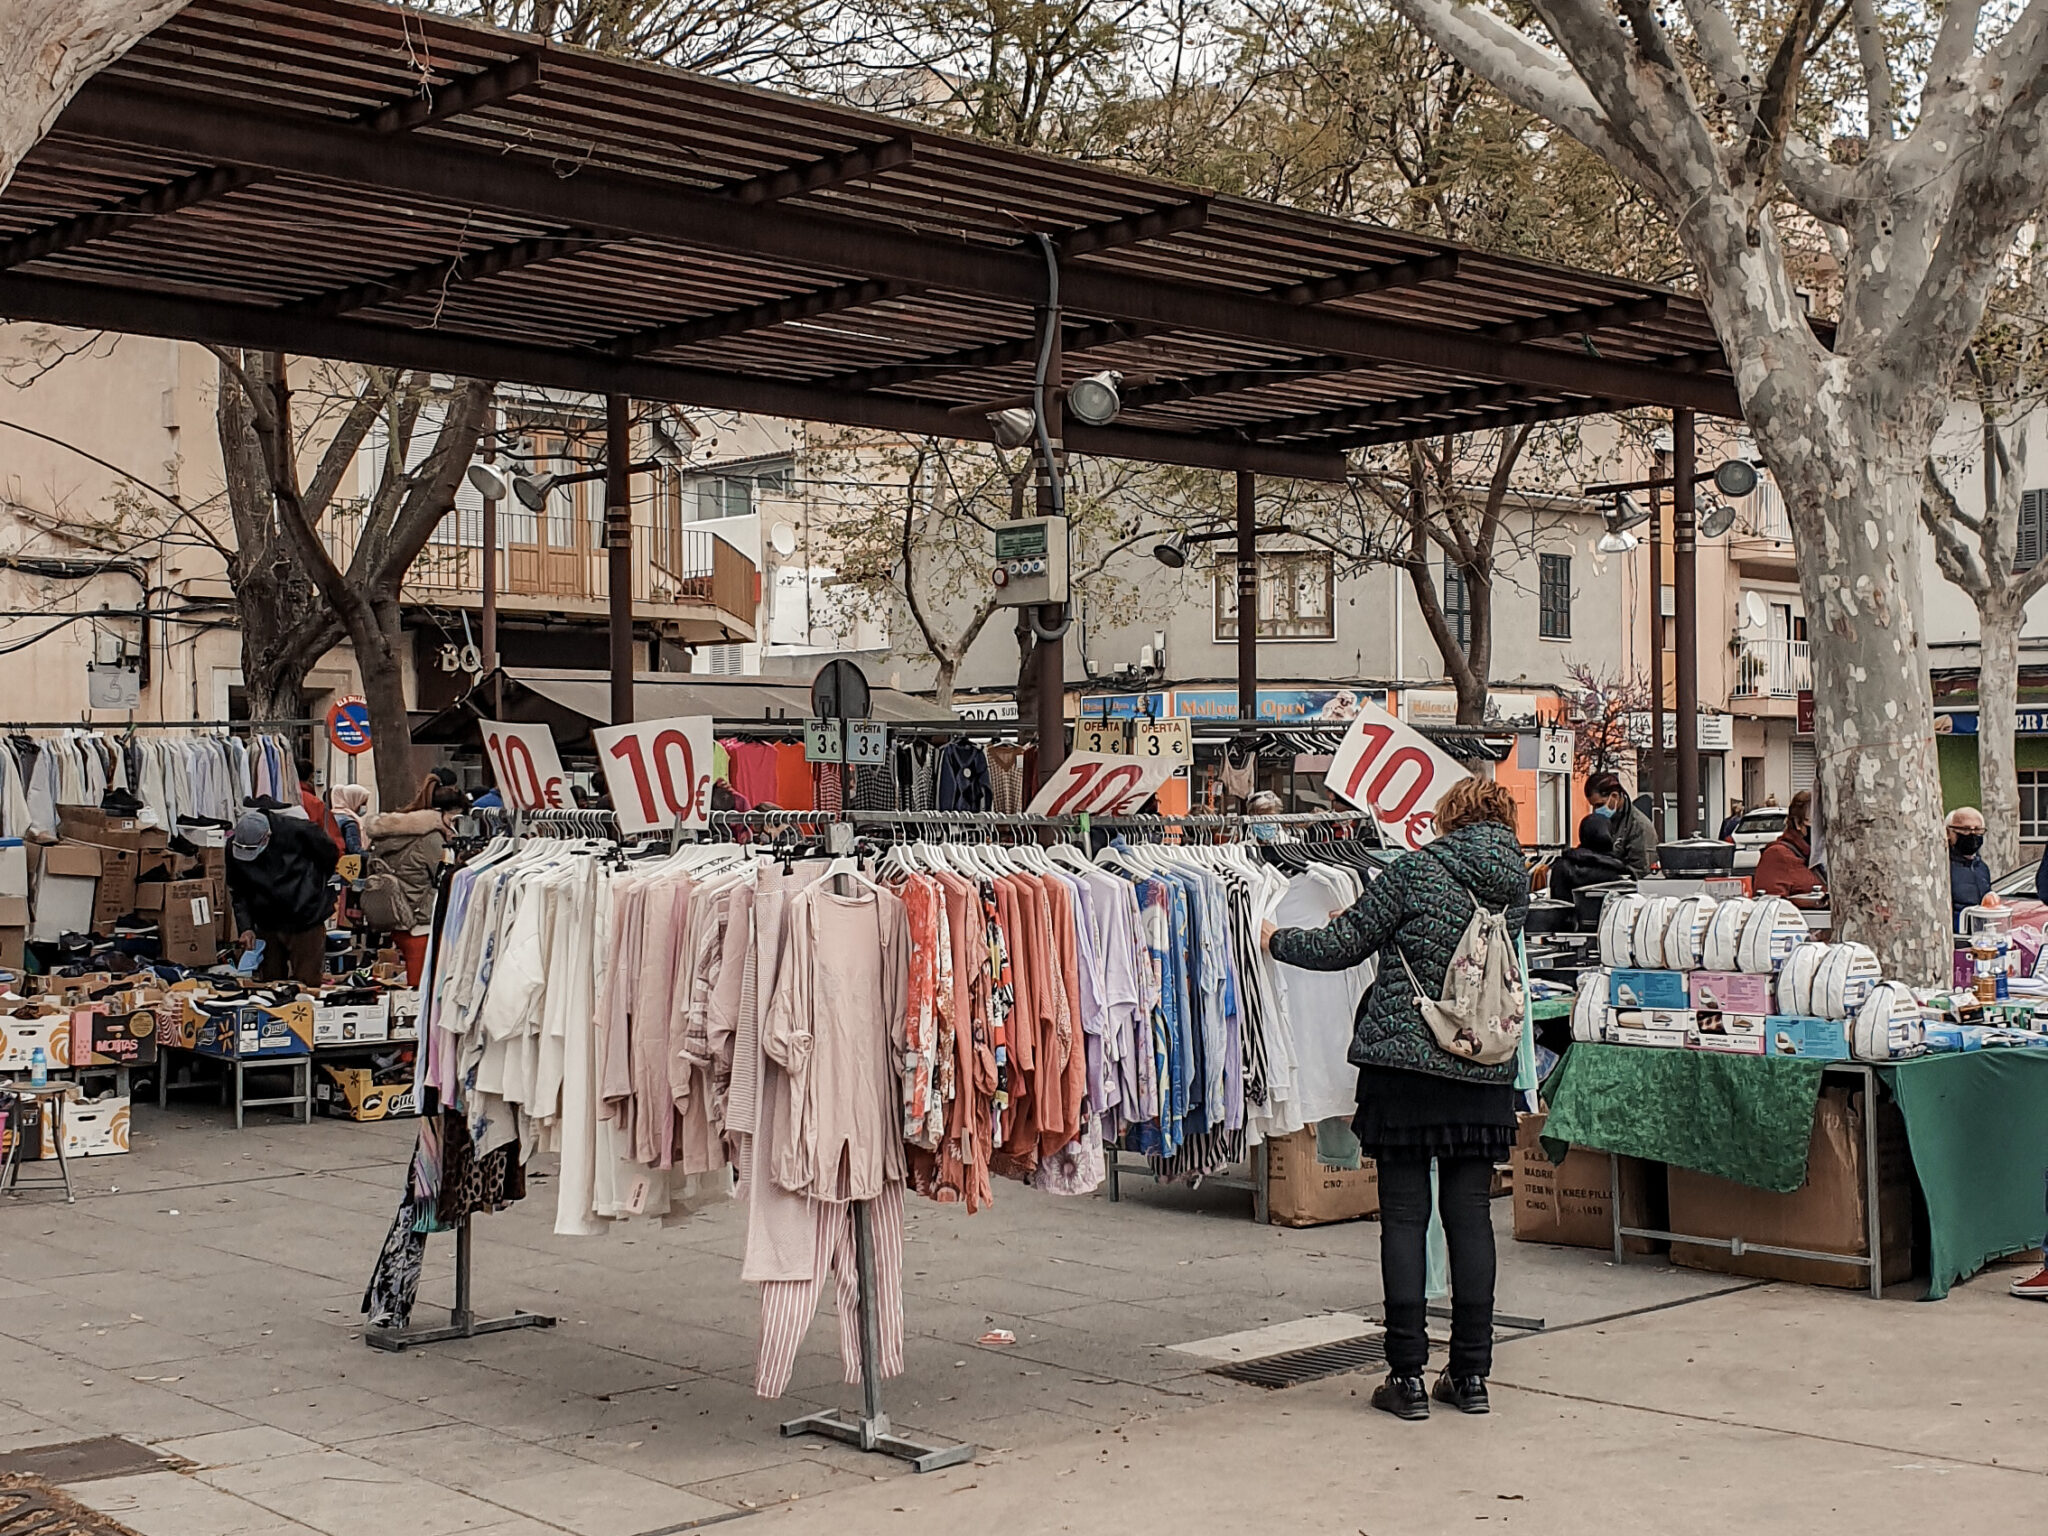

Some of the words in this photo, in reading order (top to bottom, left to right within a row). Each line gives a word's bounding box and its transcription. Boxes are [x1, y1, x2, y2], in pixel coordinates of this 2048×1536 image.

[1140, 722, 1182, 734] OFERTA
[817, 734, 827, 754] 3
[830, 740, 838, 754] €
[859, 735, 869, 756] 3
[872, 743, 881, 756] €
[1088, 733, 1102, 753] 3
[1110, 739, 1120, 754] €
[1147, 735, 1161, 757] 3
[1171, 740, 1183, 754] €
[1544, 733, 1570, 745] OFERTA
[1548, 745, 1557, 765] 3
[1560, 752, 1568, 765] €
